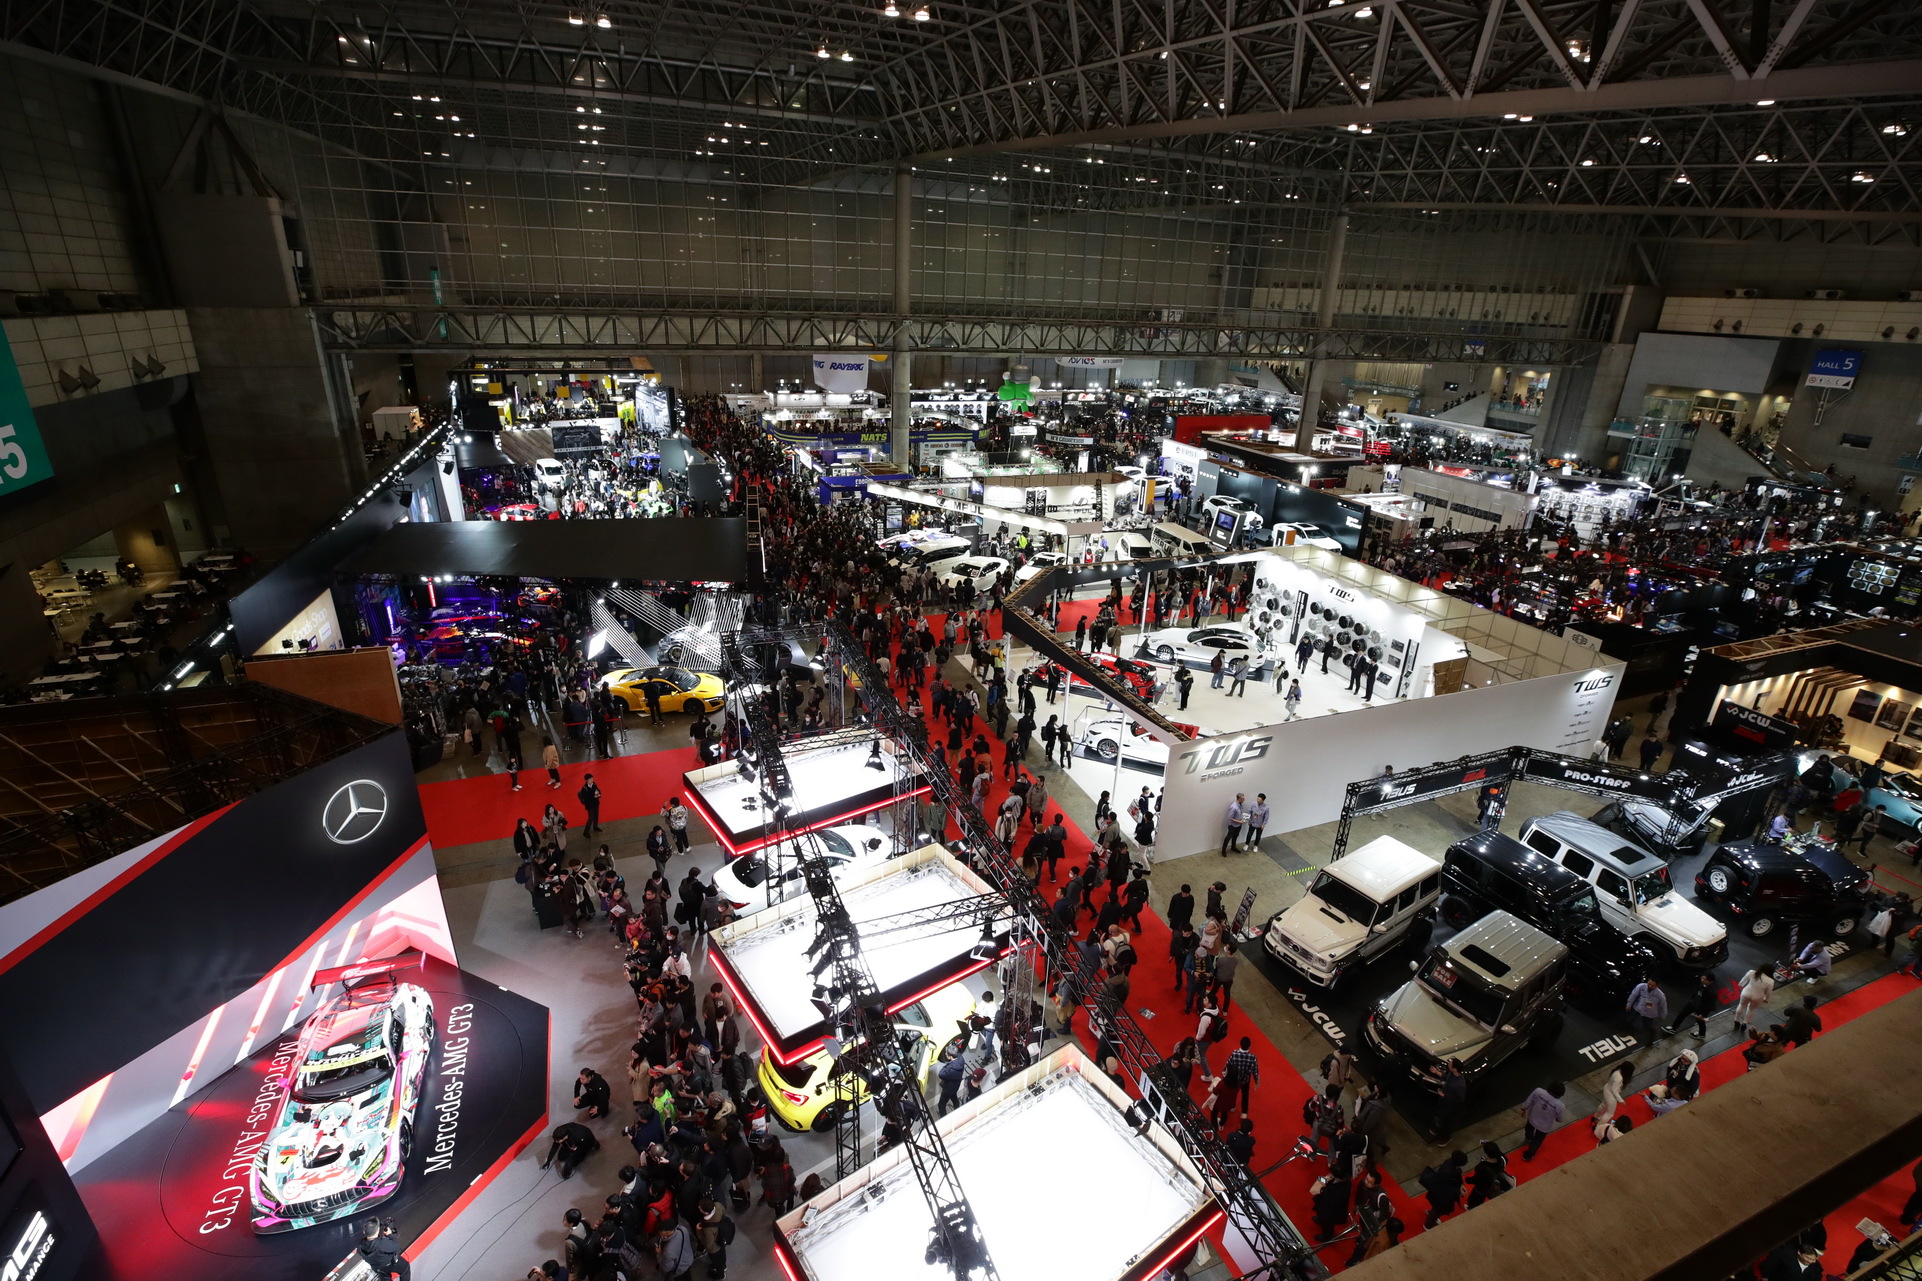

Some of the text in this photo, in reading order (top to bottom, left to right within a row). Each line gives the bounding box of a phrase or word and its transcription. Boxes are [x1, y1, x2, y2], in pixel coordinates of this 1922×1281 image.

[830, 362, 865, 371] RAYBRIG
[1817, 358, 1855, 370] HALL 5
[861, 433, 888, 442] NATS
[1754, 580, 1770, 590] 906
[1574, 675, 1614, 693] TWS
[1739, 711, 1771, 728] JCW
[1179, 736, 1273, 775] TWS
[1564, 769, 1633, 789] PRO-STAFF
[1433, 971, 1452, 986] SALE
[1436, 966, 1451, 979] FOR
[1302, 1002, 1347, 1040] JCW
[1578, 1034, 1638, 1063] TIBUS
[424, 1003, 474, 1175] Mercedes-AMG GT3
[199, 1185, 245, 1234] GT3
